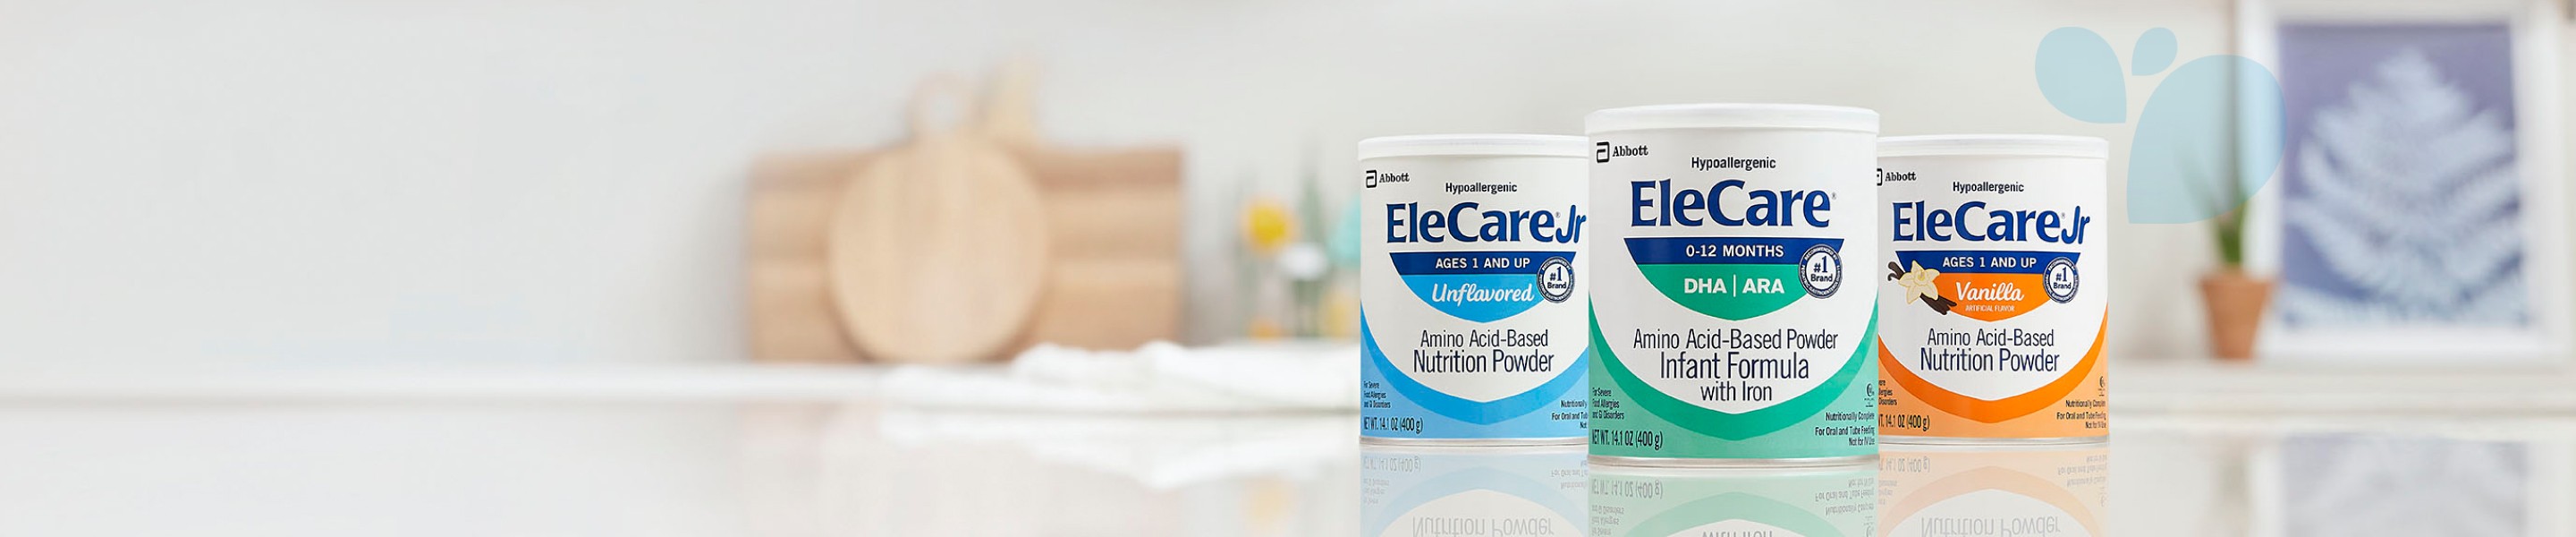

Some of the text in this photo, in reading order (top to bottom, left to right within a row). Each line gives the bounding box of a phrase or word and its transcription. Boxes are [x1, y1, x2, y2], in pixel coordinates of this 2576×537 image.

[1613, 145, 1648, 158] Abbott
[1691, 157, 1776, 171] Hypoallergenic
[1379, 172, 1410, 183] Abbott
[1885, 171, 1917, 182] Abbott
[1445, 182, 1518, 194] Hypoallergenic
[1953, 181, 2024, 194] Hypoallergenic
[1631, 178, 1831, 227] EleCare
[1686, 244, 1784, 257] 0-12 MONTHS
[1436, 258, 1467, 268] AGES
[1472, 258, 1479, 268] 1
[1484, 258, 1510, 268] AND
[1513, 258, 1530, 268] UP
[1814, 256, 1828, 273] #1
[1943, 257, 1974, 268] AGES
[1979, 257, 1986, 268] 1
[1990, 257, 2017, 268] AND
[2021, 257, 2038, 268] UP
[1549, 266, 1562, 282] #1
[1810, 274, 1834, 282] Brand
[1684, 278, 1785, 294] DHA ARA
[1956, 281, 2024, 303] Vanilla
[1432, 282, 1534, 306] Unflavored
[1995, 304, 2015, 312] FLAVOR
[1420, 329, 1548, 347] Amino Acid-Based
[1633, 328, 1838, 349] Amino Acid-Based Powder
[1927, 328, 2055, 346] Amino Acid-Based
[1413, 350, 1555, 373] Nutrition Powder
[1660, 351, 1809, 379] Infant Formula
[1920, 347, 2060, 372] Nutrition Powder
[1598, 388, 1612, 396] Severe
[1700, 380, 1772, 401] with Iron
[1601, 399, 1620, 410] Allergies
[1552, 412, 1560, 421] For
[1562, 412, 1572, 421] Oral
[1572, 412, 1580, 420] and
[1604, 410, 1624, 420] Disorders
[1826, 411, 1858, 422] Nutritionally
[2057, 412, 2065, 420] For
[2066, 412, 2075, 420] Oral
[2076, 412, 2085, 420] and
[1379, 417, 1389, 430] 14.1
[1391, 417, 1398, 431] OZ
[1400, 417, 1415, 432] (400
[1415, 417, 1424, 435] g)
[1885, 413, 1895, 428] 14.1
[1897, 413, 1905, 428] OZ
[1906, 413, 1921, 430] (400
[1922, 414, 1930, 431] g)
[1815, 426, 1825, 436] For
[1826, 426, 1838, 436] Oral
[1839, 426, 1848, 436] and
[1850, 425, 1860, 435] Tube
[1600, 429, 1610, 446] WT.
[1612, 430, 1623, 446] 14.1
[1624, 430, 1634, 447] OZ
[1635, 430, 1653, 448] (400
[1655, 430, 1664, 451] g)
[1849, 437, 1857, 446] Not
